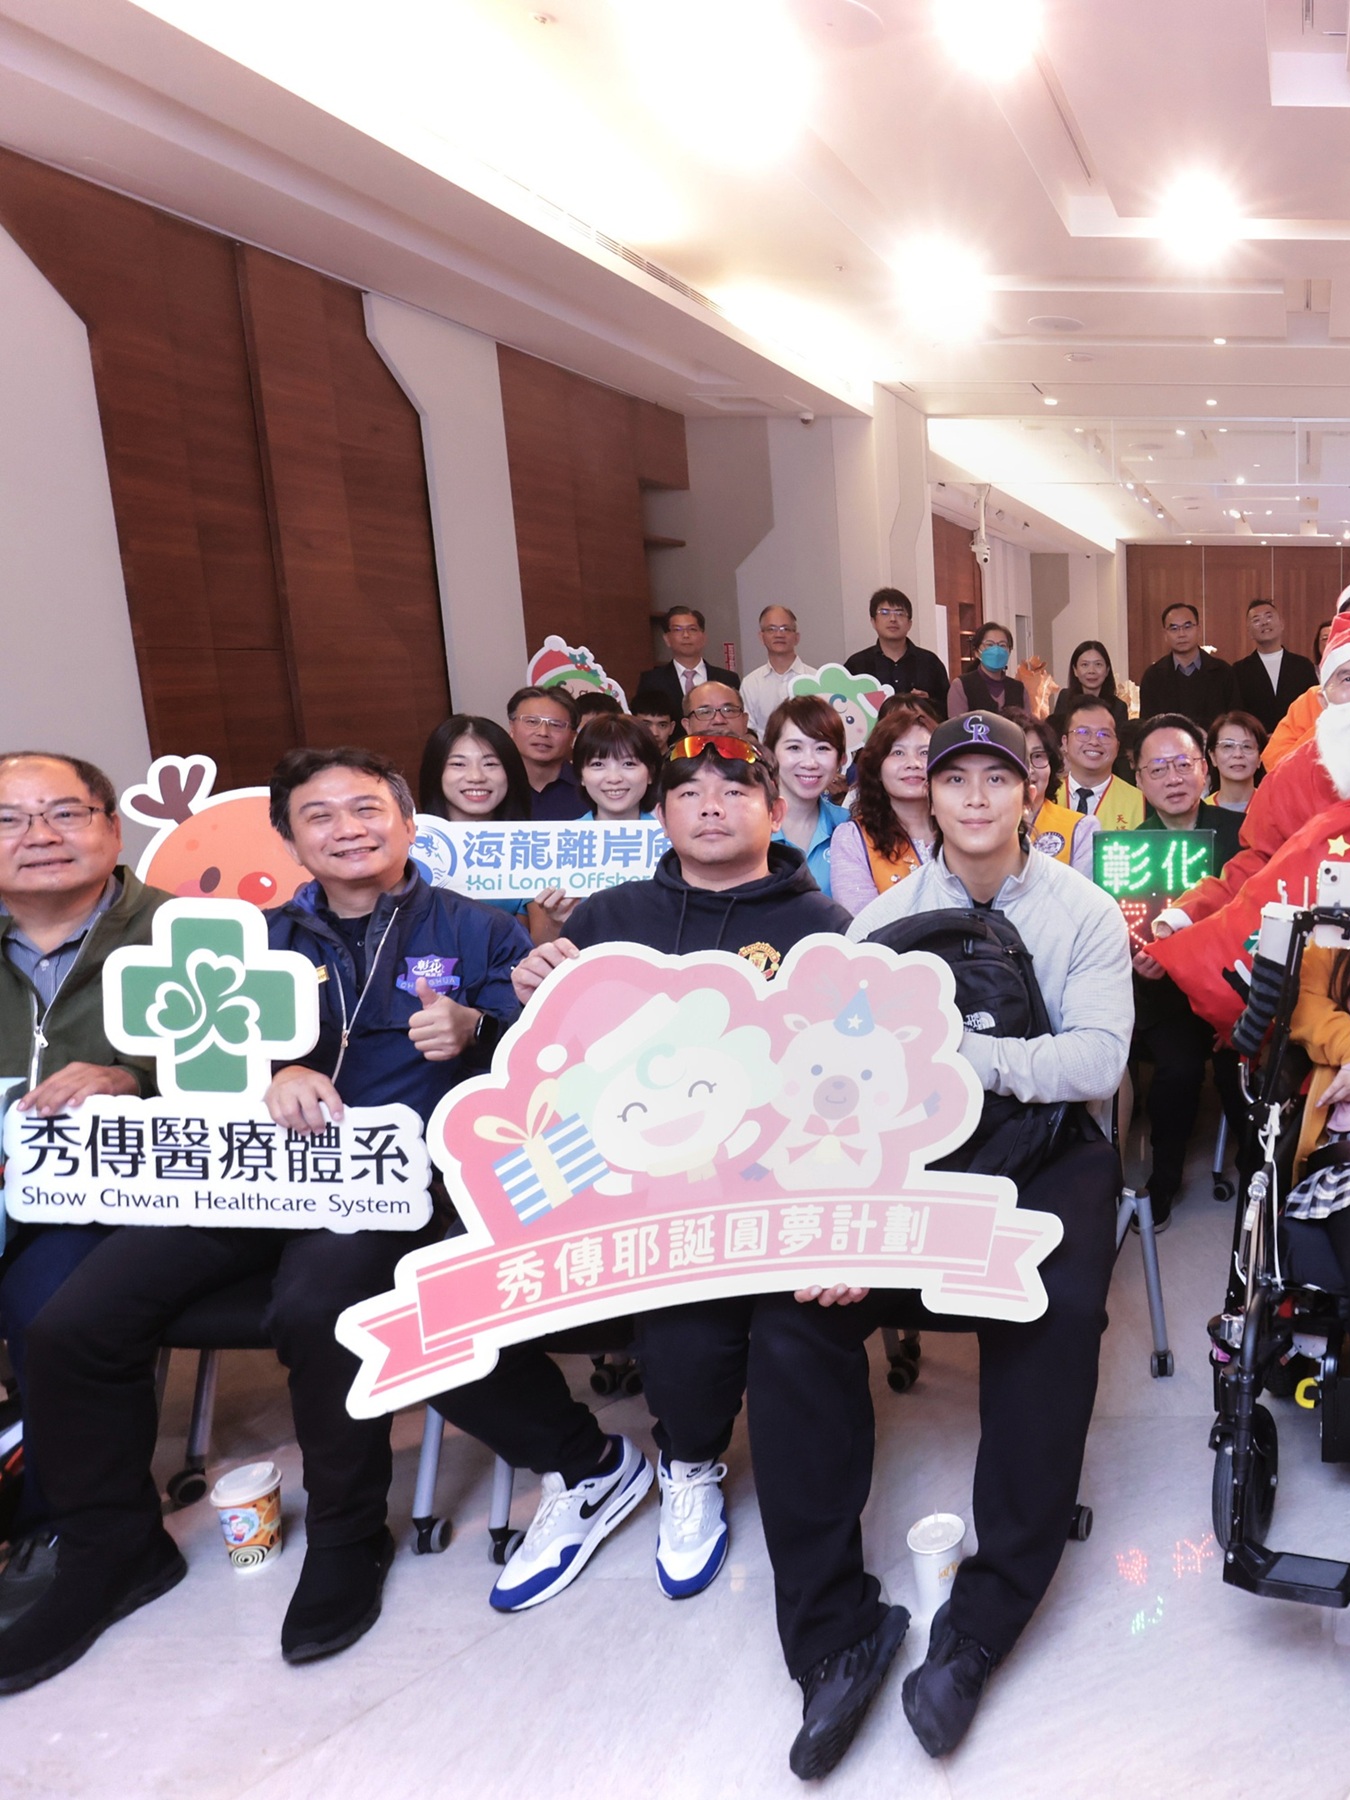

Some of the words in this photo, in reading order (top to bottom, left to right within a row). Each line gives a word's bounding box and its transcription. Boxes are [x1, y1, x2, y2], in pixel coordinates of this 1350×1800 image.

[466, 873, 502, 891] Hai
[509, 874, 561, 890] Long
[1102, 841, 1207, 894] 彰化
[400, 976, 456, 989] CHGHUA
[21, 1114, 409, 1184] 秀傳醫療體系
[22, 1186, 86, 1206] Show
[100, 1188, 179, 1208] Chwan
[194, 1190, 317, 1212] Healthcare
[329, 1194, 410, 1217] System
[497, 1203, 930, 1310] 秀傳耶誕圓夢計劃
